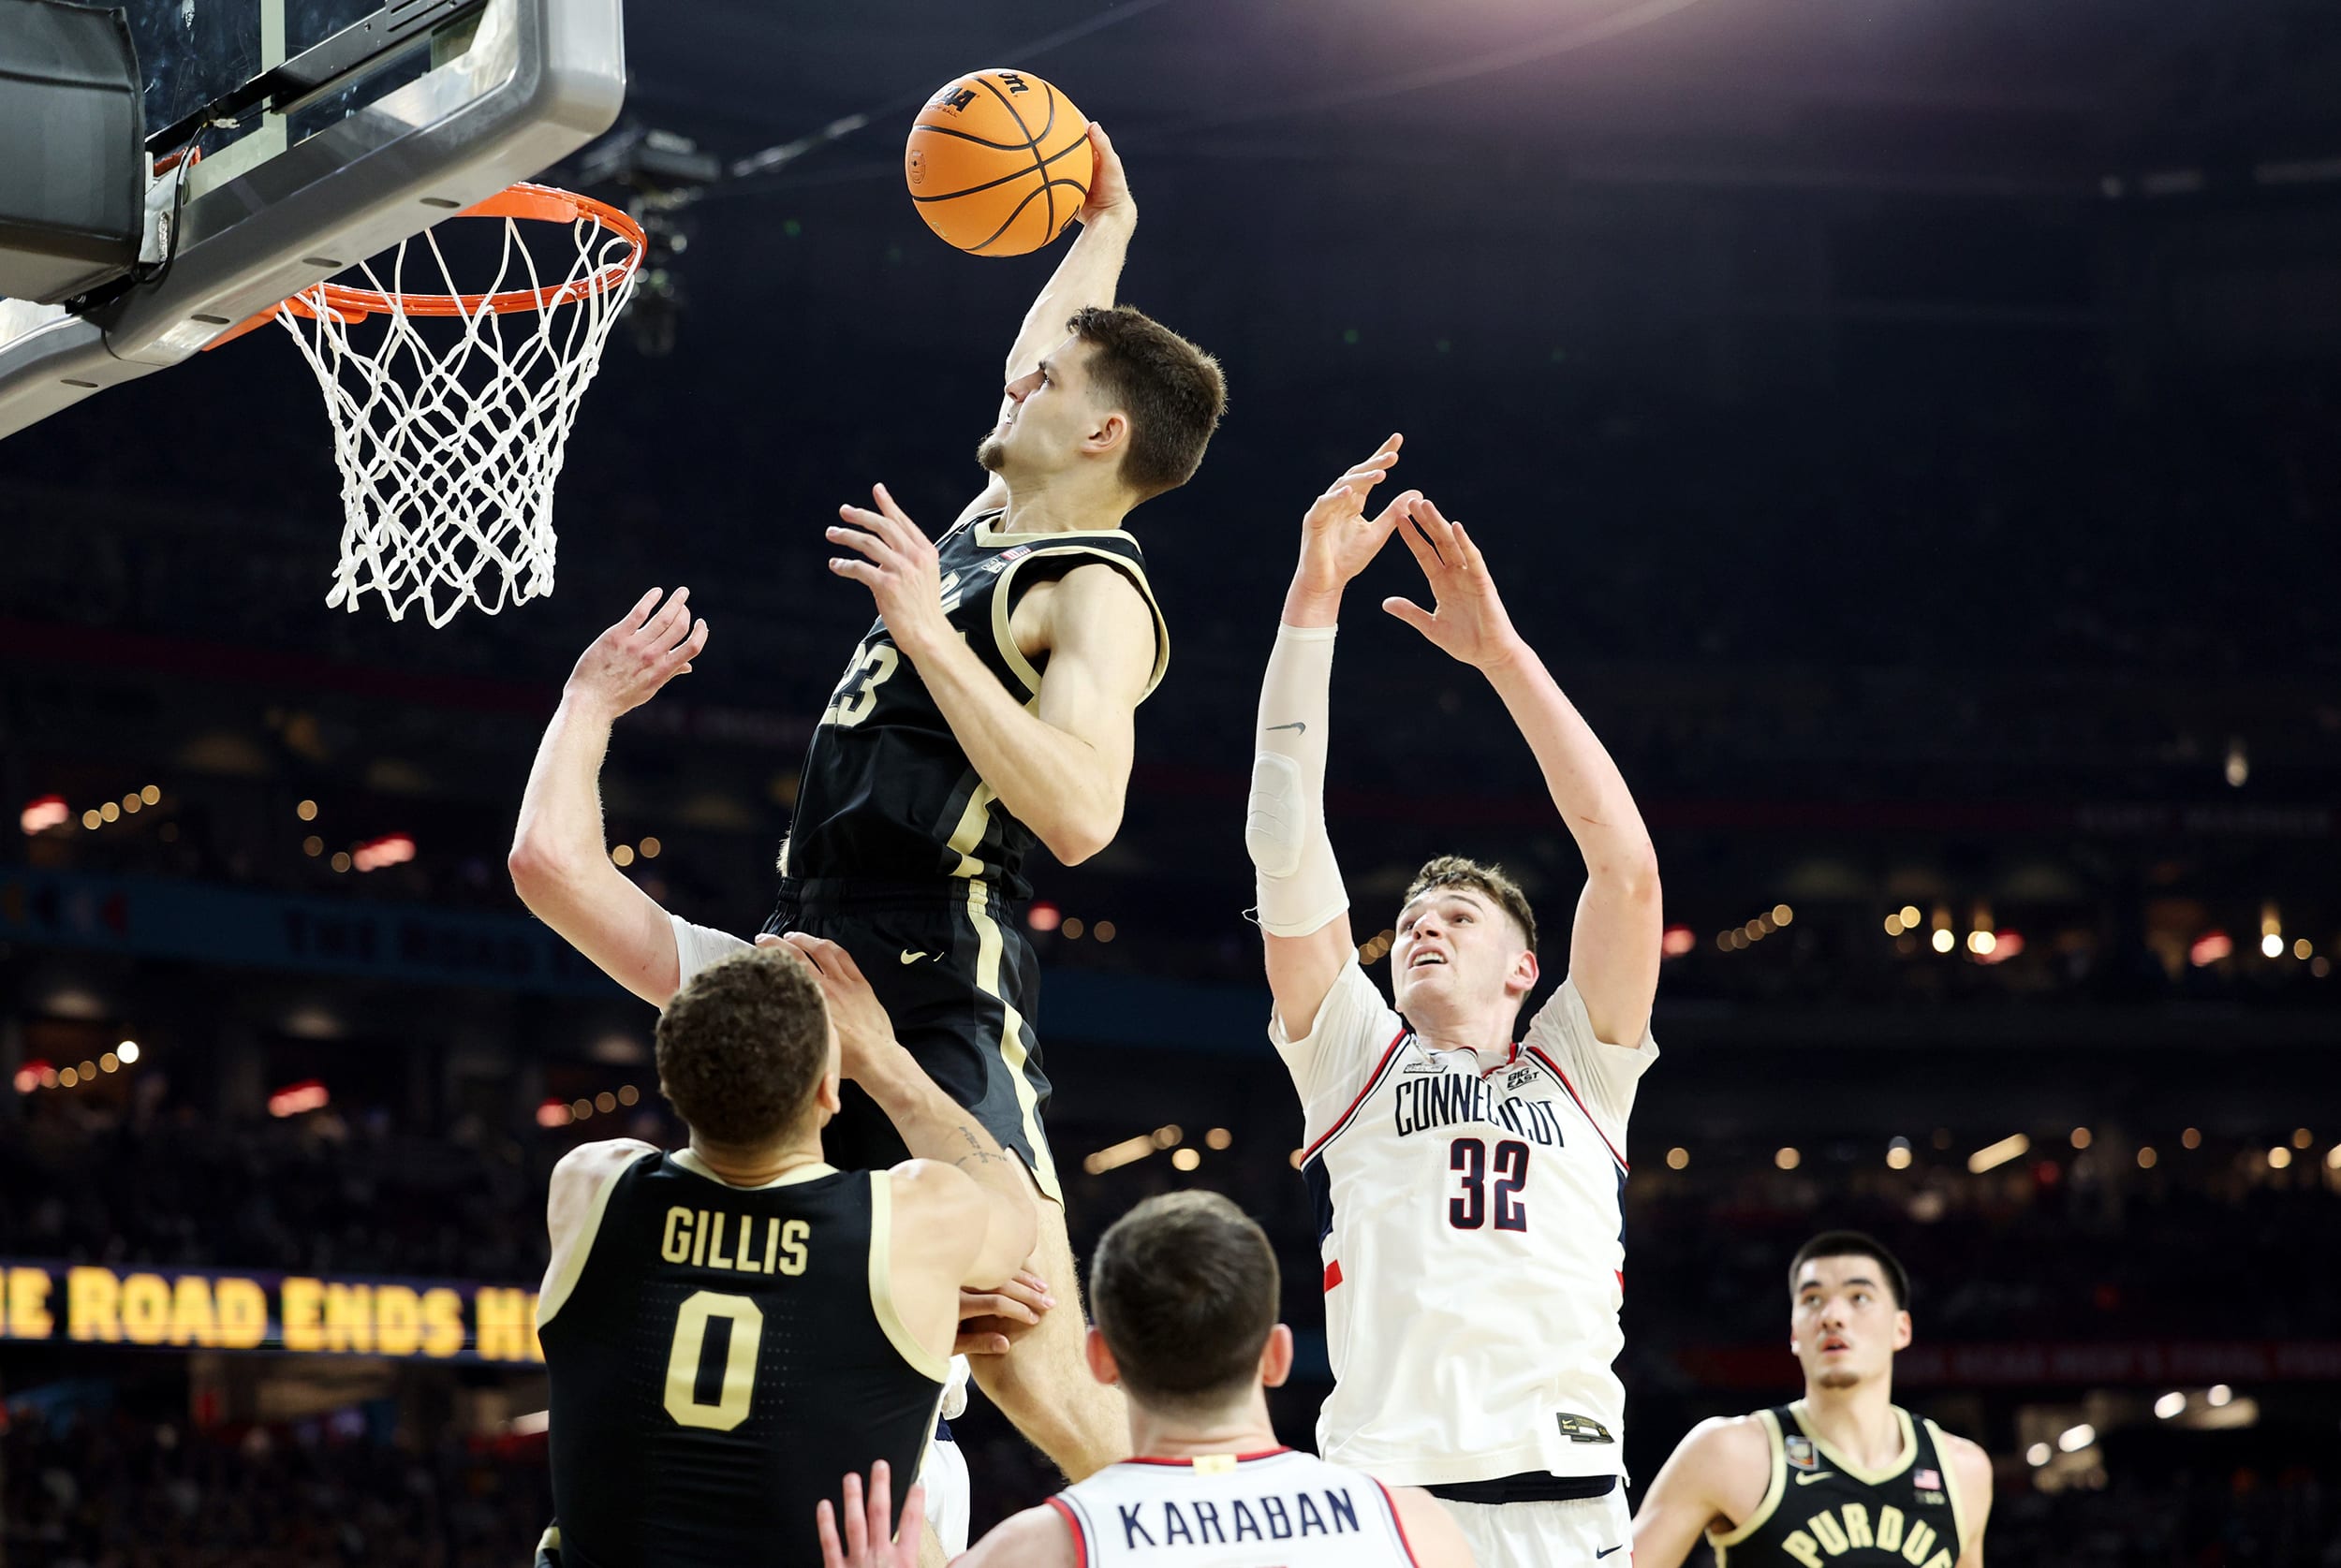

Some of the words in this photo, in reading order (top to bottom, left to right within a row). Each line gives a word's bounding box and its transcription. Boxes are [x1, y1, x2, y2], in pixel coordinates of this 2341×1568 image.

[1395, 1073, 1565, 1148] CONNECICUT
[1507, 1071, 1540, 1090] EAST
[1508, 1068, 1530, 1082] BIG
[1450, 1137, 1530, 1232] 32
[661, 1206, 811, 1277] GILLIS
[0, 1266, 54, 1340] E
[66, 1266, 268, 1349] ROAD
[281, 1276, 466, 1358] ENDS
[663, 1289, 765, 1431] 0
[1118, 1487, 1361, 1549] KARABAN
